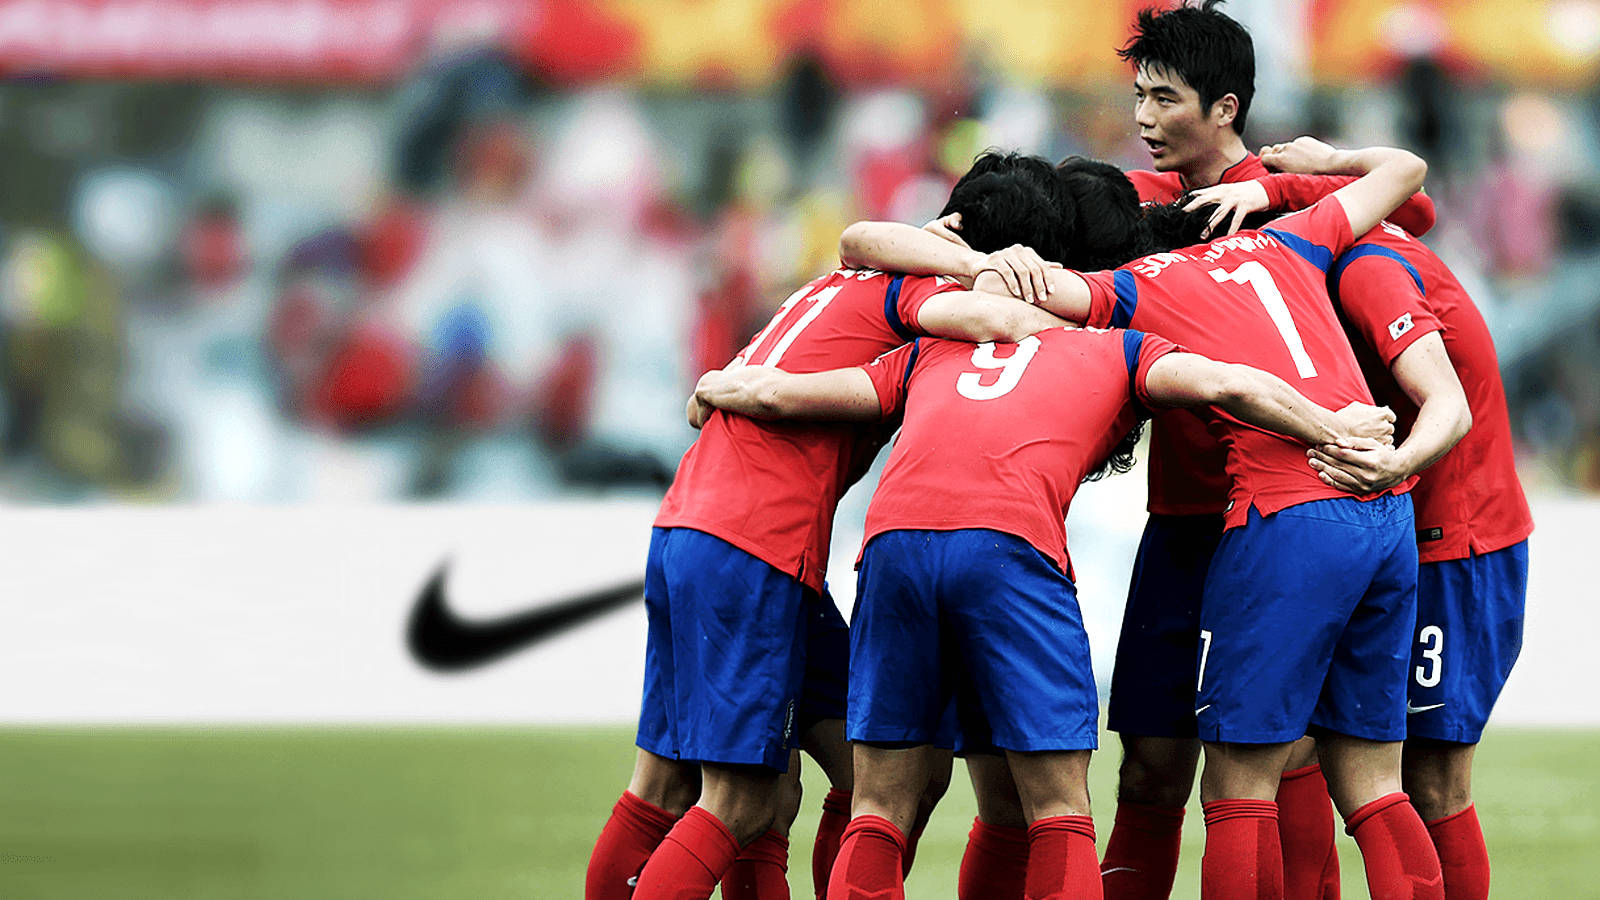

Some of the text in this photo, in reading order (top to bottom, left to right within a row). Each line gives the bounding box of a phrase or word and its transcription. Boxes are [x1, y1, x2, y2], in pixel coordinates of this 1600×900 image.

[1207, 260, 1319, 380] 7
[956, 335, 1042, 401] 9
[1415, 625, 1444, 688] 3
